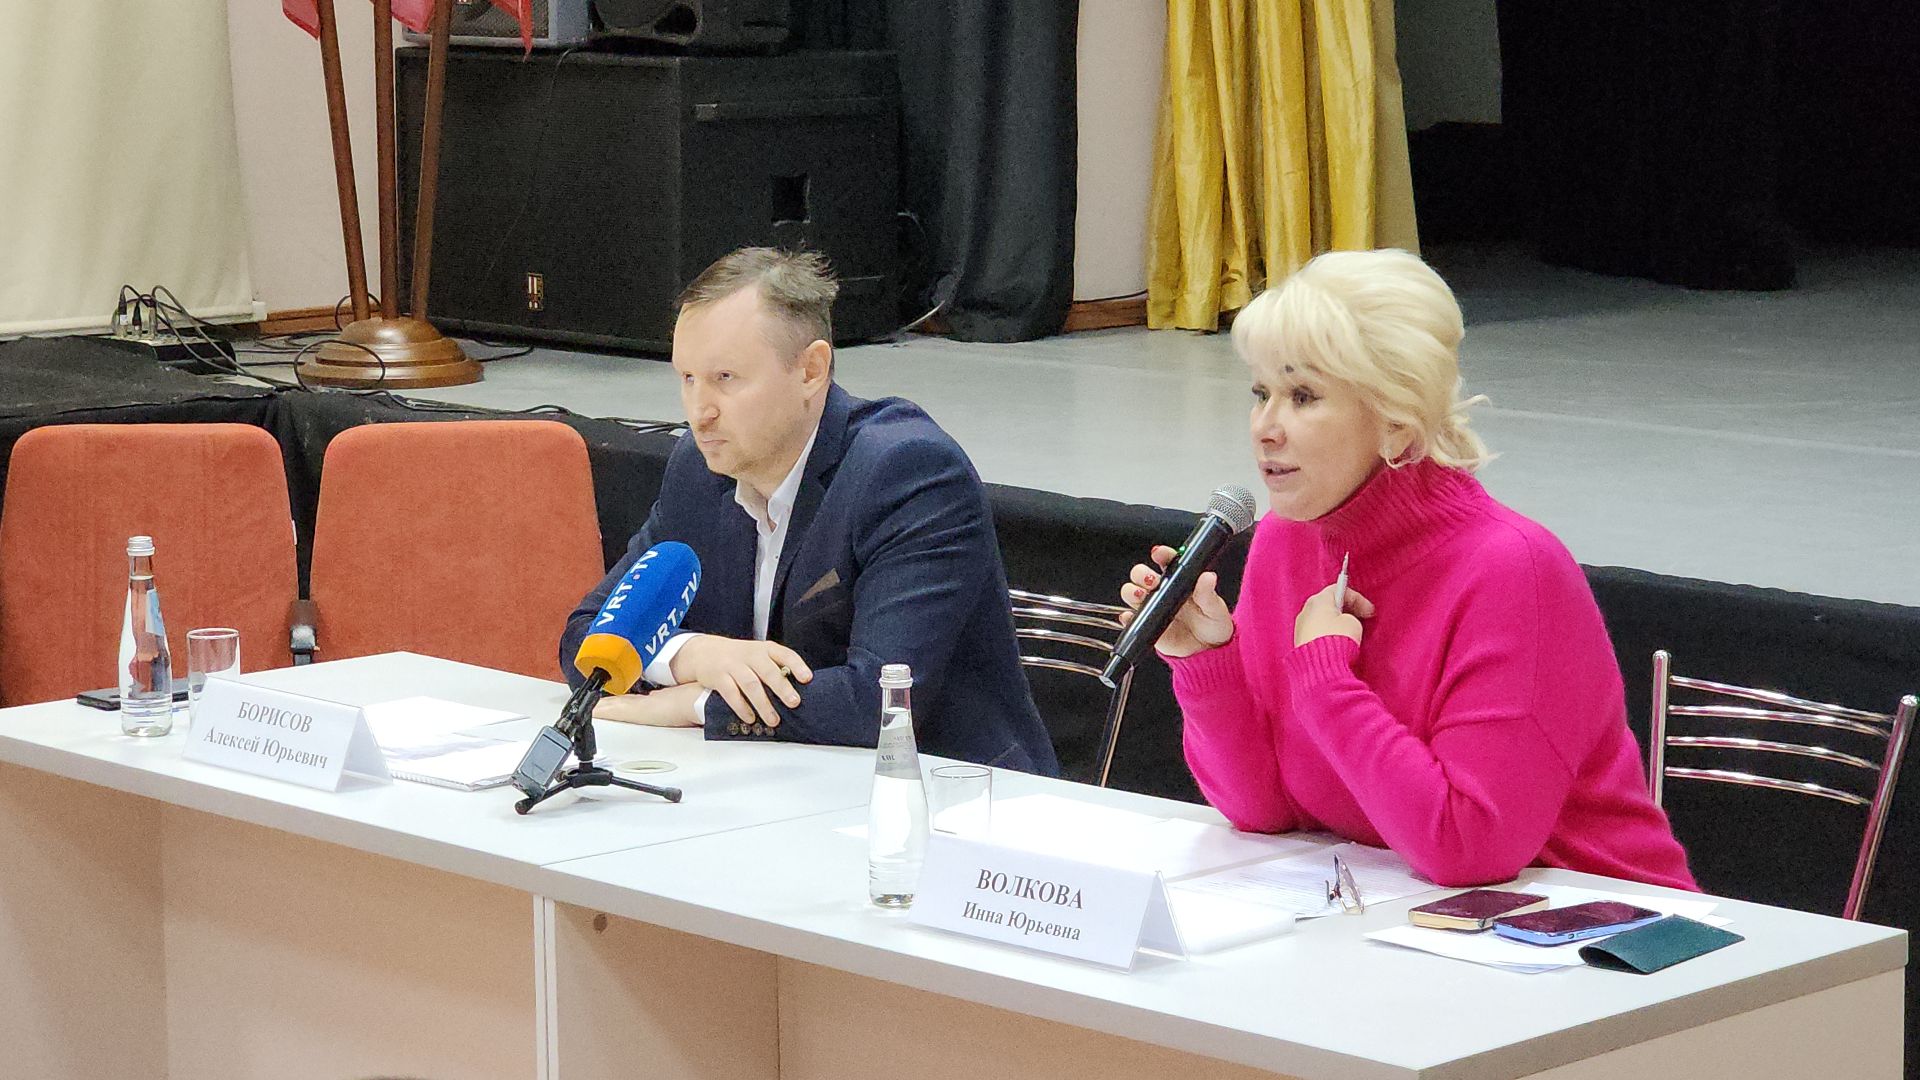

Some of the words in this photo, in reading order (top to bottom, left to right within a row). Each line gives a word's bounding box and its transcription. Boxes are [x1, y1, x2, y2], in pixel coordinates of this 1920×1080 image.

[237, 701, 313, 733] БОРИСОВ
[204, 727, 260, 753] Алексей
[262, 738, 328, 769] Юрьевич
[976, 869, 1083, 910] ВОЛКОВА
[961, 901, 1004, 925] Инна
[1006, 910, 1081, 942] Юрьевна
